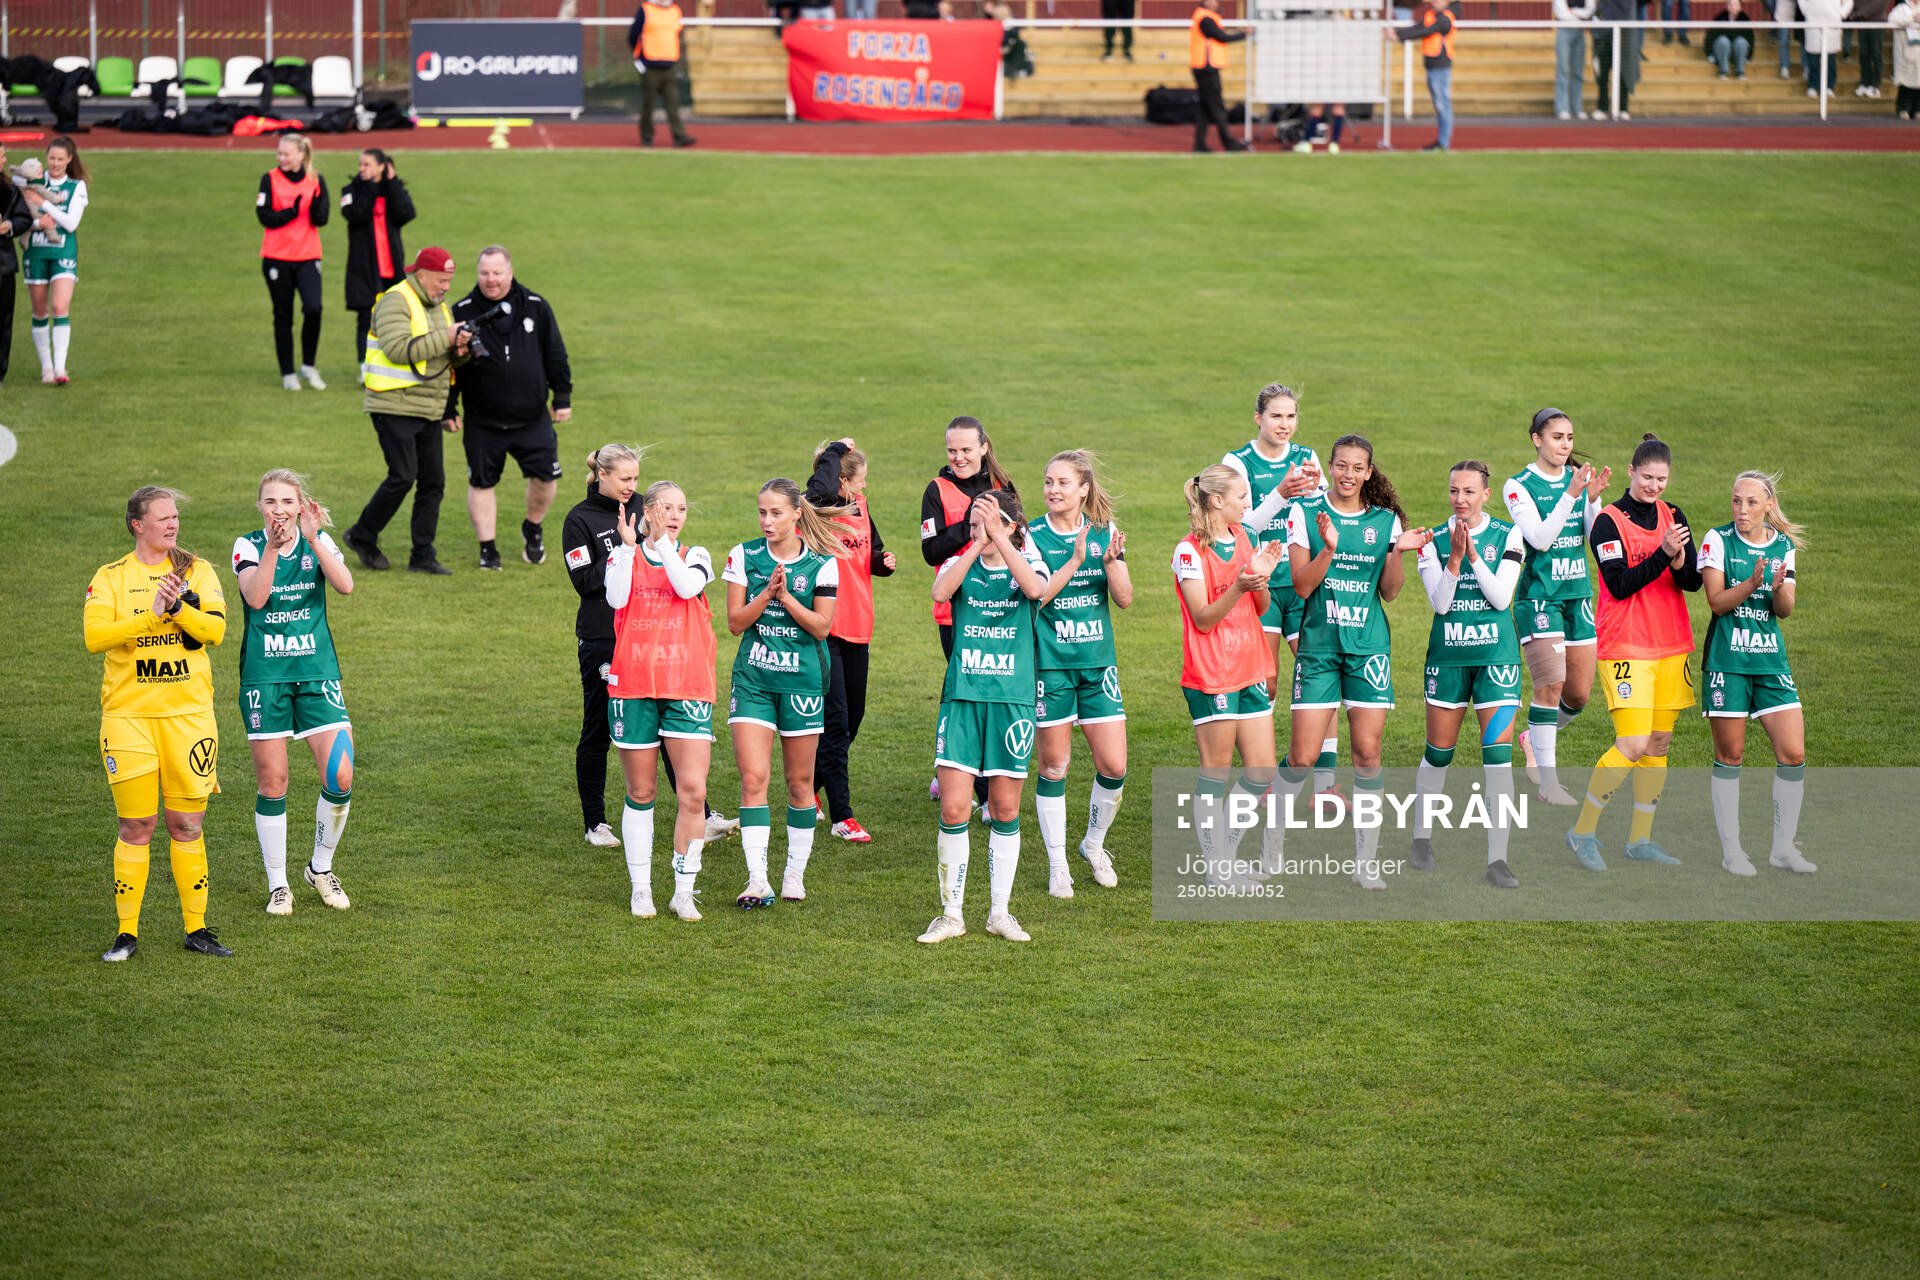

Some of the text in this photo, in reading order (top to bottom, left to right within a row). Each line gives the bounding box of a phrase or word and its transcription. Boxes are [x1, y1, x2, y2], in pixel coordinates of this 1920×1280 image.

[847, 31, 931, 63] FORZA
[443, 55, 578, 76] RO-GRUPPEN
[814, 67, 964, 112] ROSENGÅRD
[604, 538, 613, 552] 9
[1332, 552, 1375, 563] arbanken
[1552, 557, 1585, 577] MAXI
[270, 581, 316, 594] parbanken
[1324, 578, 1370, 593] SERNEKE
[968, 596, 1020, 608] Sparbanken
[1054, 594, 1100, 610] SERNEKE
[1325, 600, 1369, 621] MAXI
[1449, 599, 1491, 611] ERNEK
[264, 608, 311, 624] SERNEKE
[762, 609, 785, 617] lingsås
[756, 623, 798, 639] RNEKE
[963, 624, 1018, 639] SERNEKE
[1055, 619, 1103, 638] MAXI
[1444, 622, 1499, 641] MAXI
[1731, 627, 1778, 648] MAXI
[136, 631, 184, 648] SERNEK
[264, 633, 316, 652] MAXI
[748, 641, 800, 668] MAXI
[961, 648, 1016, 670] MAXI
[136, 658, 190, 678] MAXI
[1613, 661, 1632, 680] 22
[1037, 680, 1045, 698] 8
[1709, 671, 1725, 688] 24
[246, 689, 261, 709] 12
[612, 699, 624, 718] 11
[955, 863, 966, 888] CRAFT
